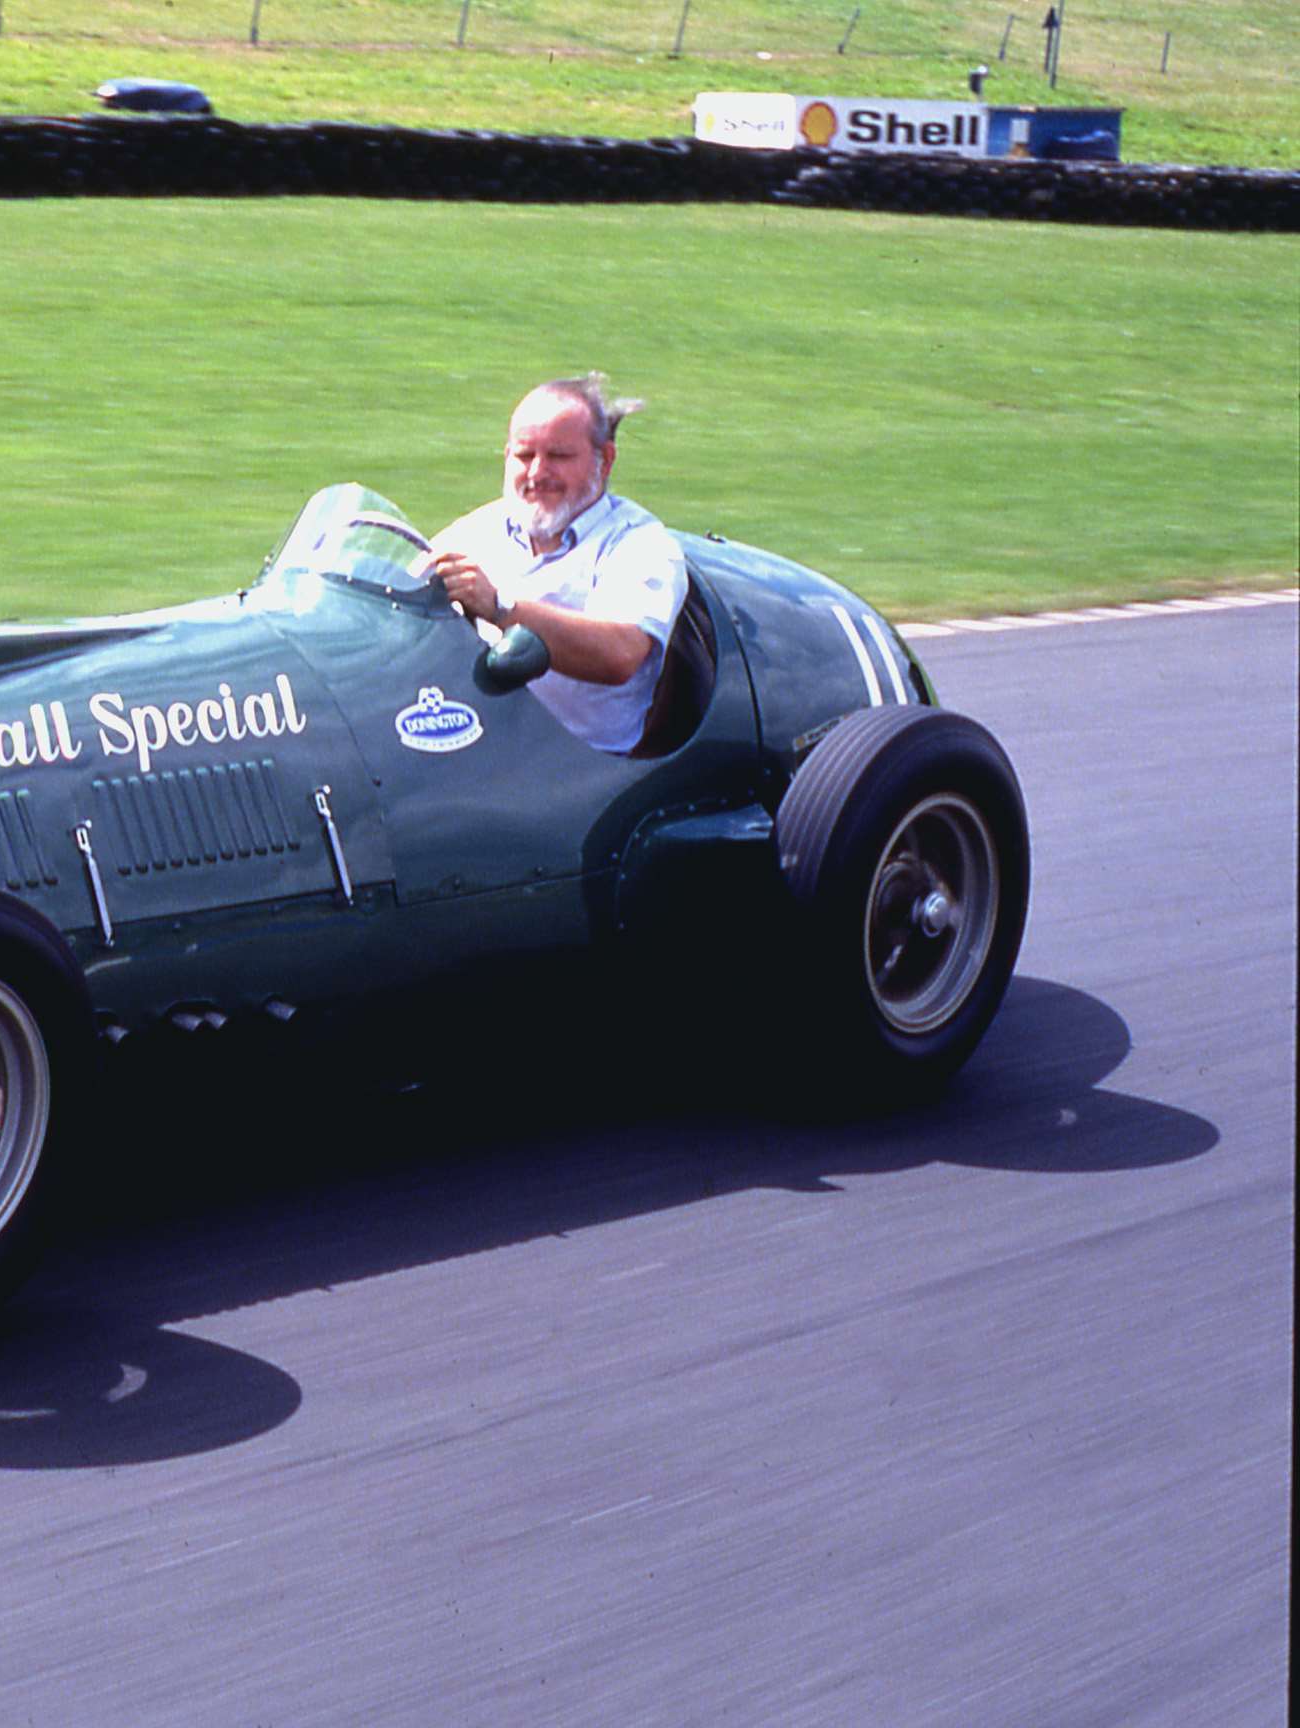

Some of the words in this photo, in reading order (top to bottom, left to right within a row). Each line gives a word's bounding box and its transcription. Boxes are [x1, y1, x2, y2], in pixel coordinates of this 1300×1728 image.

[847, 110, 980, 146] Shell
[88, 673, 307, 772] Special
[404, 711, 470, 734] DONINGTON
